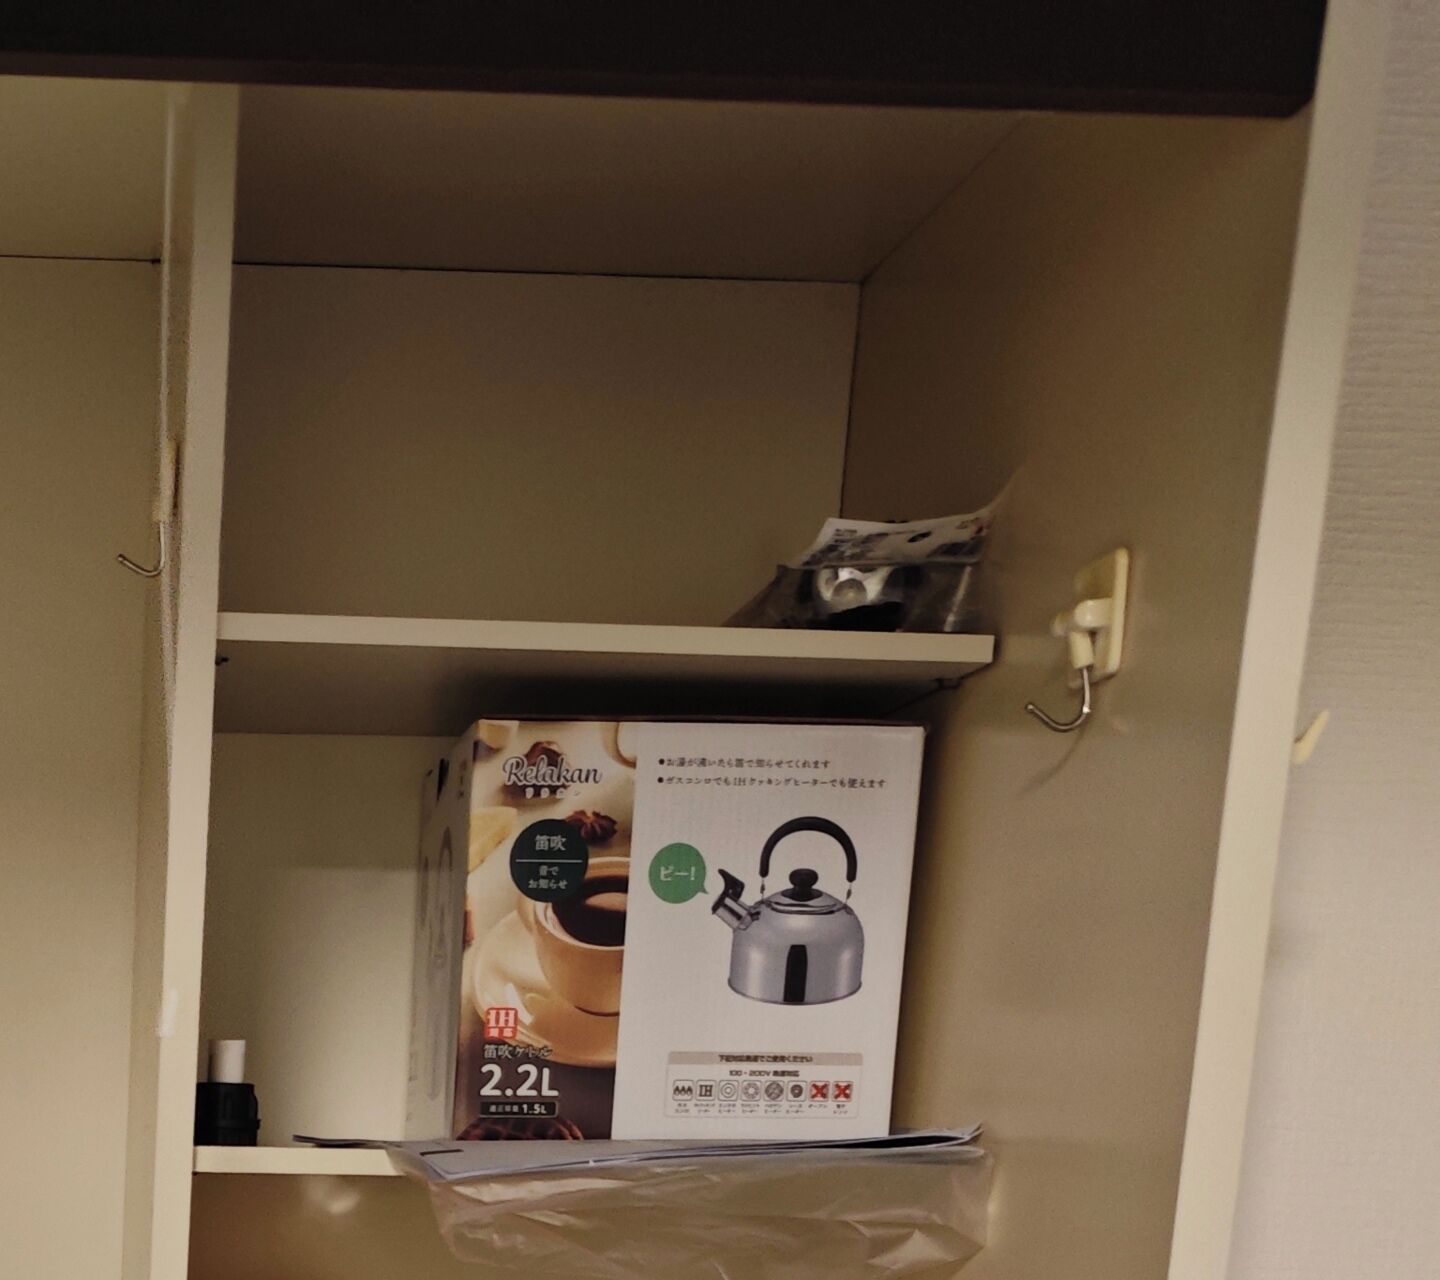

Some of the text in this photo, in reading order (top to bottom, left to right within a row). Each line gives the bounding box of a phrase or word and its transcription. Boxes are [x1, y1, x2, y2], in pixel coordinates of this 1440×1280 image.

[502, 754, 602, 786] Relakan
[534, 834, 567, 851] 笛吹
[528, 880, 568, 890] お知らせ
[483, 1044, 554, 1060] 笛吹ケトル
[479, 1063, 560, 1097] 2.2L
[522, 1103, 547, 1114] 1.5L
